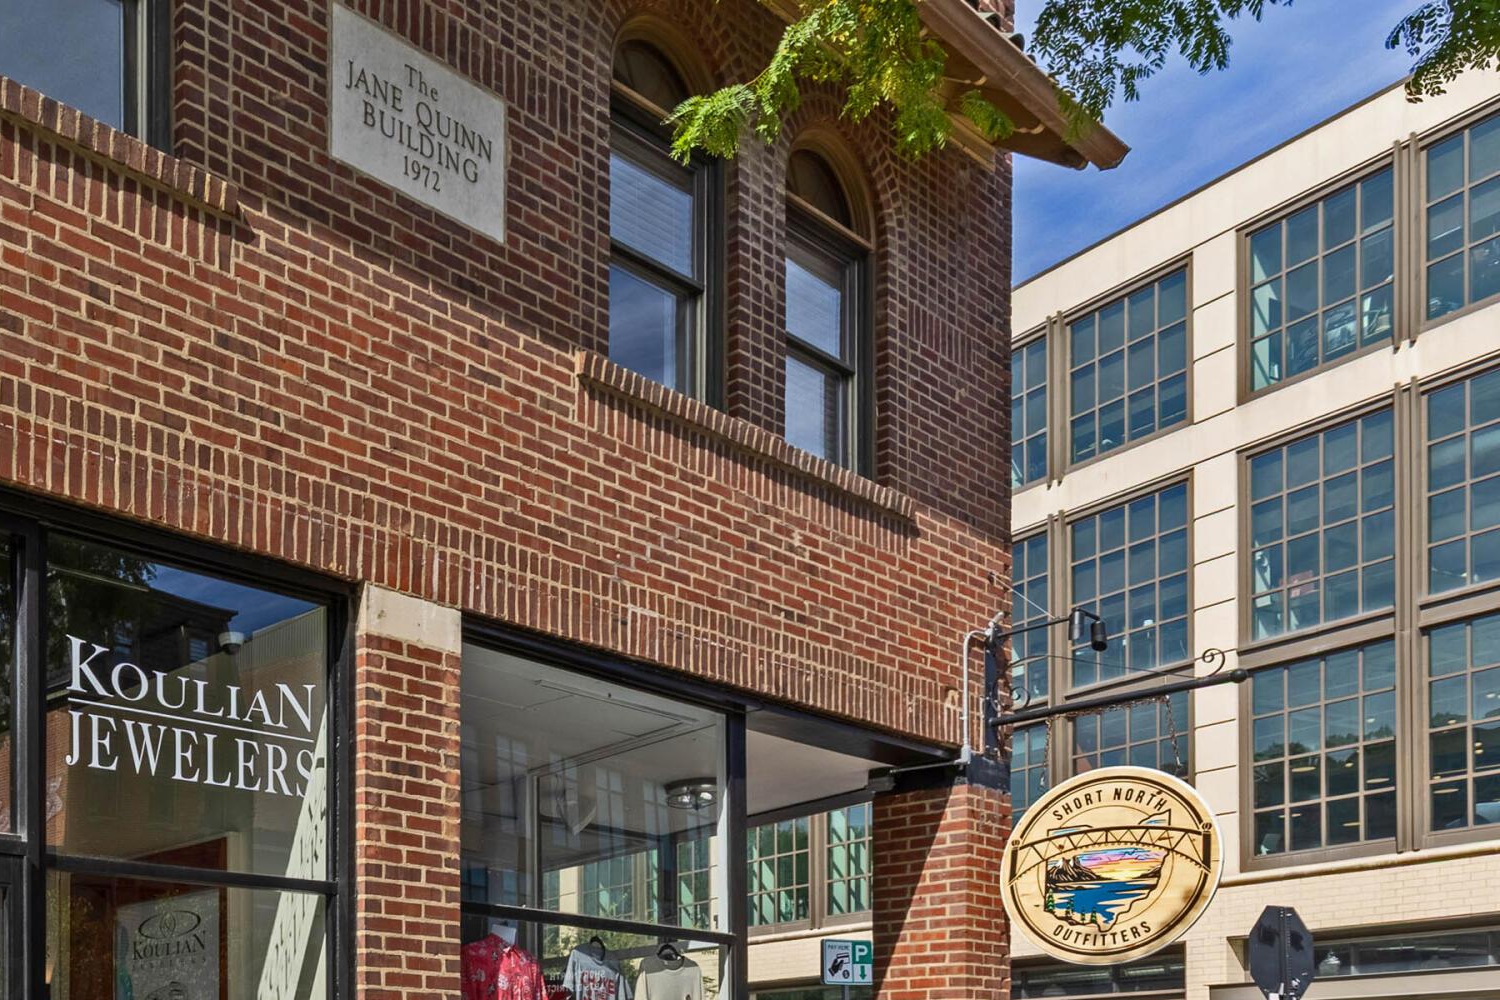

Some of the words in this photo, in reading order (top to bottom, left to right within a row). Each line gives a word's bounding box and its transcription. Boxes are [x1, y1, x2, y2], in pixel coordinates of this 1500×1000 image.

[404, 63, 439, 101] The
[345, 59, 404, 112] JANE
[416, 101, 493, 163] QUINN
[363, 99, 479, 184] BUILDING
[403, 155, 441, 192] 1972
[65, 634, 317, 733] KOULIAN
[65, 709, 319, 800] JEWELERS
[1053, 789, 1103, 821] SHORT
[1113, 787, 1168, 811] NORTH
[132, 930, 206, 960] KOULIAN
[1053, 920, 1152, 946] OUTFITTERS
[855, 945, 868, 962] P
